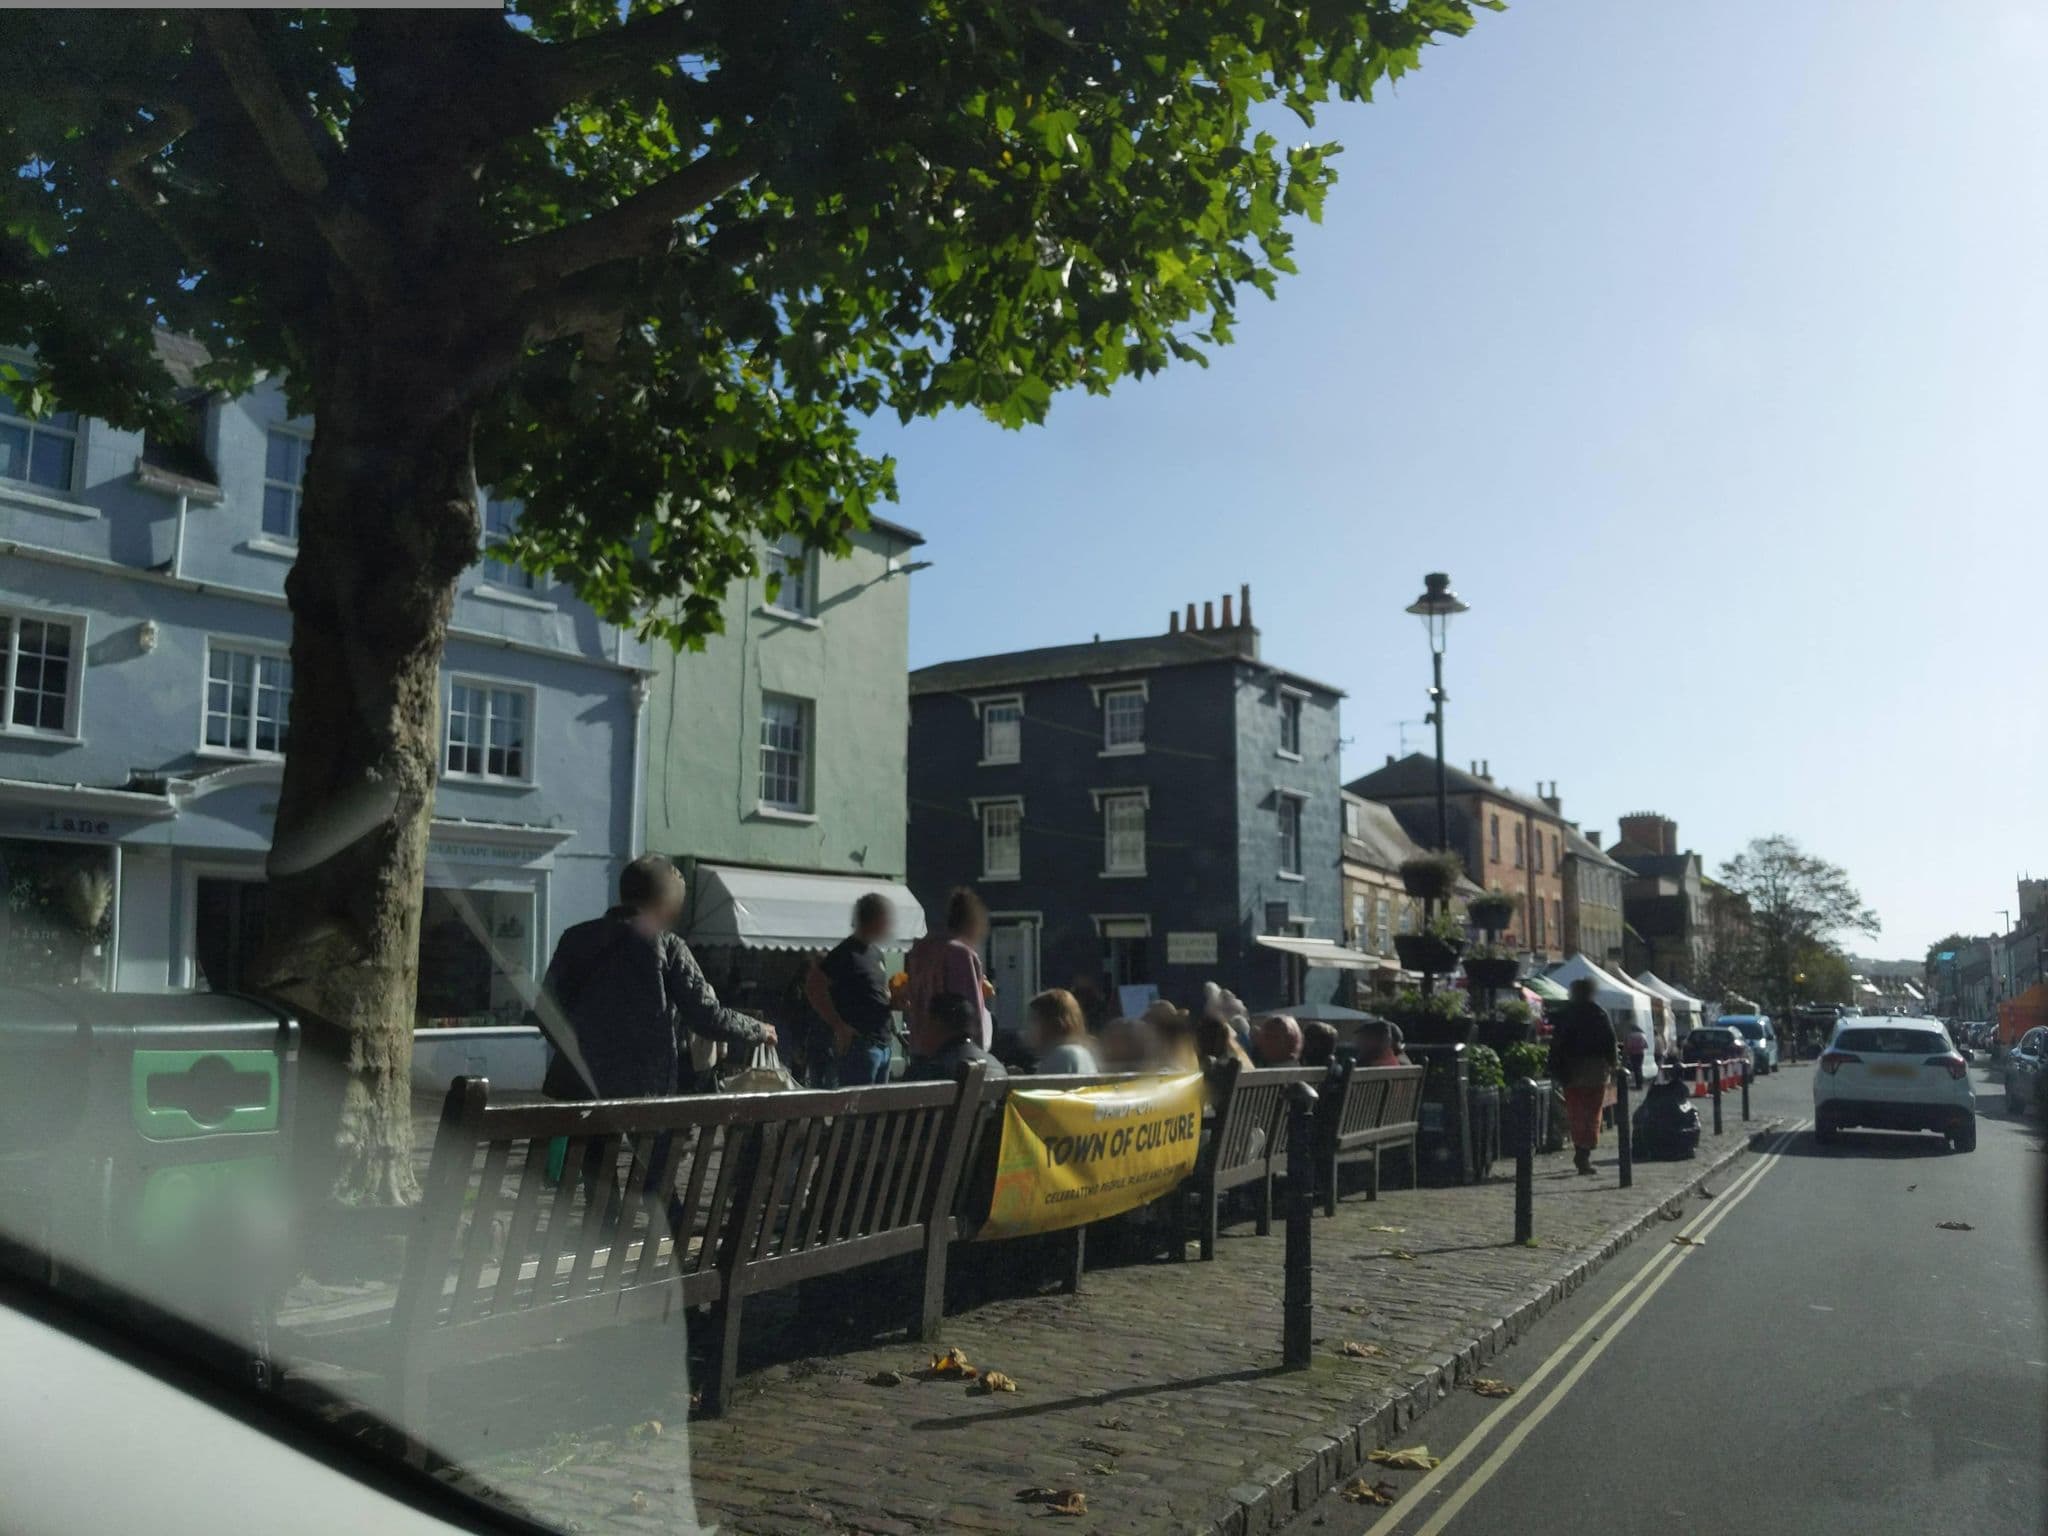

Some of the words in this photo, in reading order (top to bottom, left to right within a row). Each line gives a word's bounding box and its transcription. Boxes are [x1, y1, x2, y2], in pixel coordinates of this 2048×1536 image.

[1045, 1131, 1108, 1168] TOWN
[1110, 1126, 1134, 1159] OF
[1135, 1111, 1196, 1153] CULTURE
[1044, 1186, 1100, 1205] CELEBRATING
